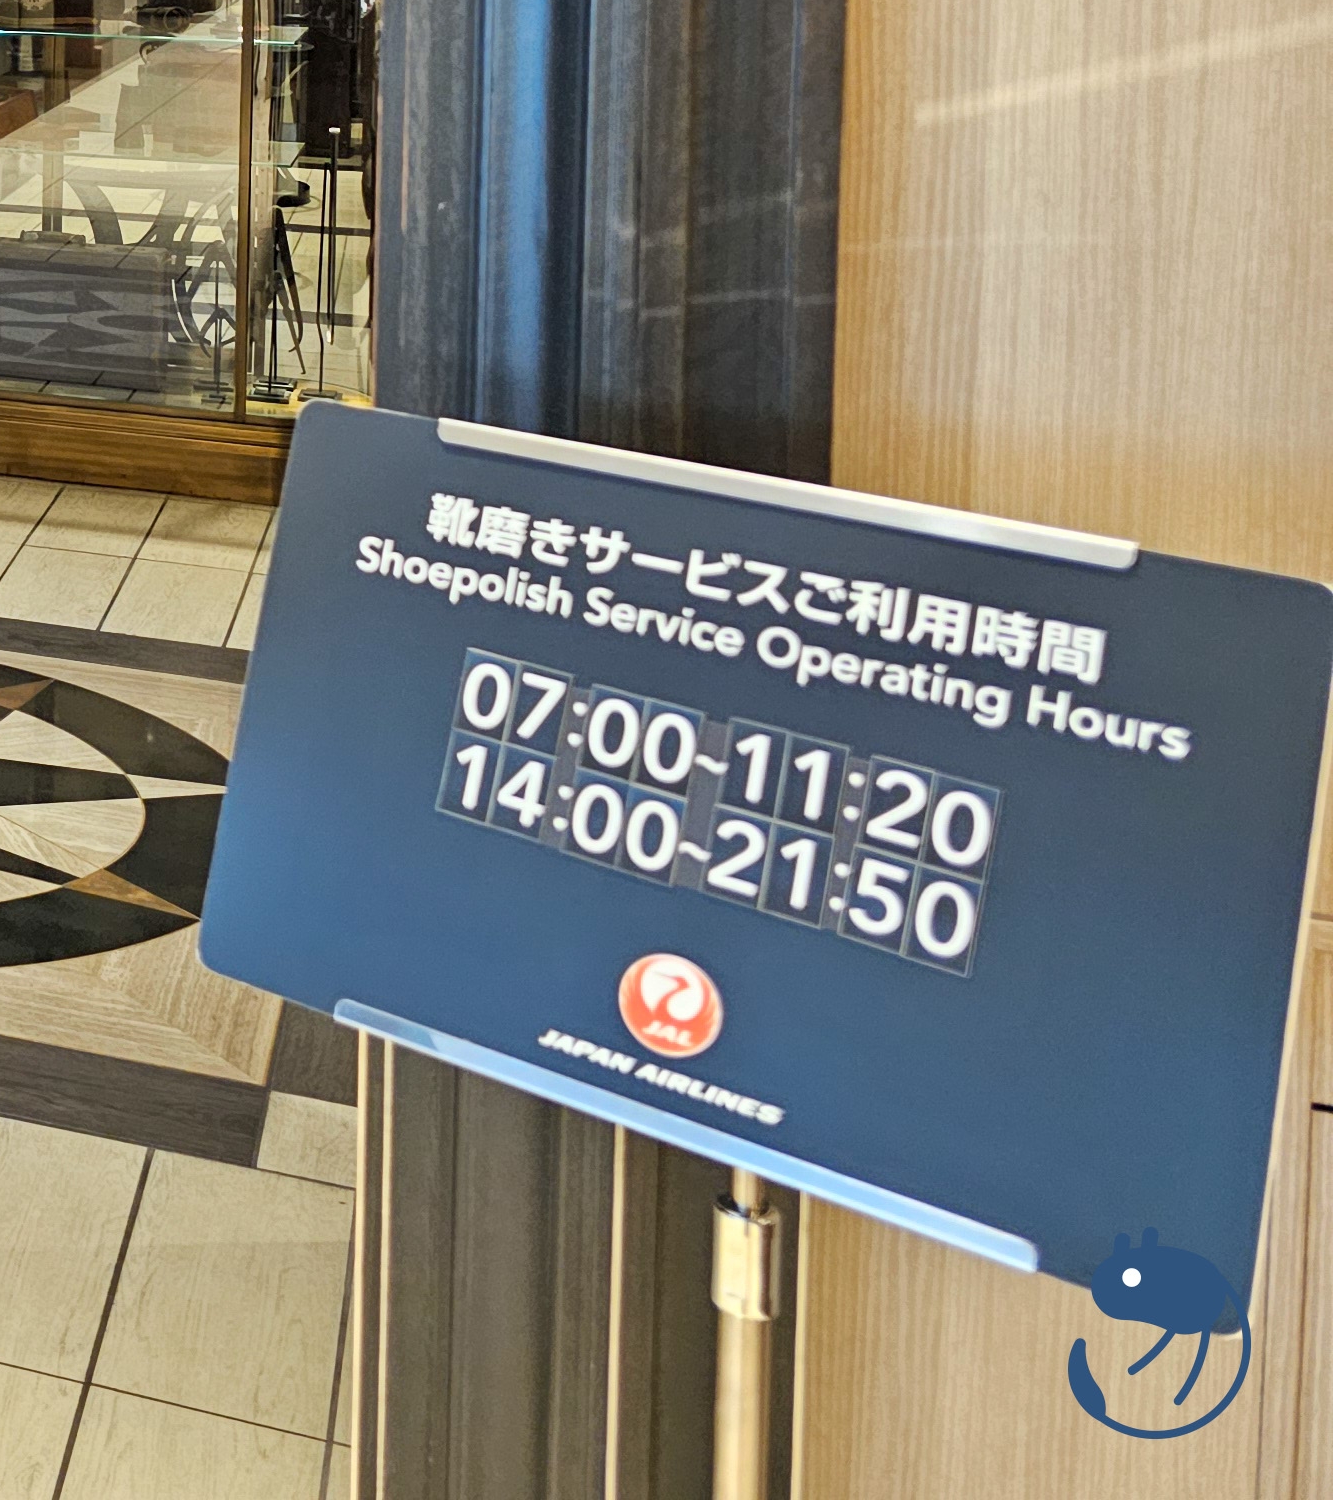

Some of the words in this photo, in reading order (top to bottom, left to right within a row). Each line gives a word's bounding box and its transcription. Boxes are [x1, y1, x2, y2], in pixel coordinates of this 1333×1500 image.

[356, 536, 573, 619] Shoepolish
[583, 587, 745, 657] Service
[756, 626, 1012, 729] Operating
[1026, 685, 1191, 761] Hours
[427, 493, 1107, 684] 靴磨きサービスご利用時間
[538, 1028, 637, 1074] JAPAN
[634, 1063, 785, 1125] AIRLINES
[642, 1020, 692, 1047] JAL
